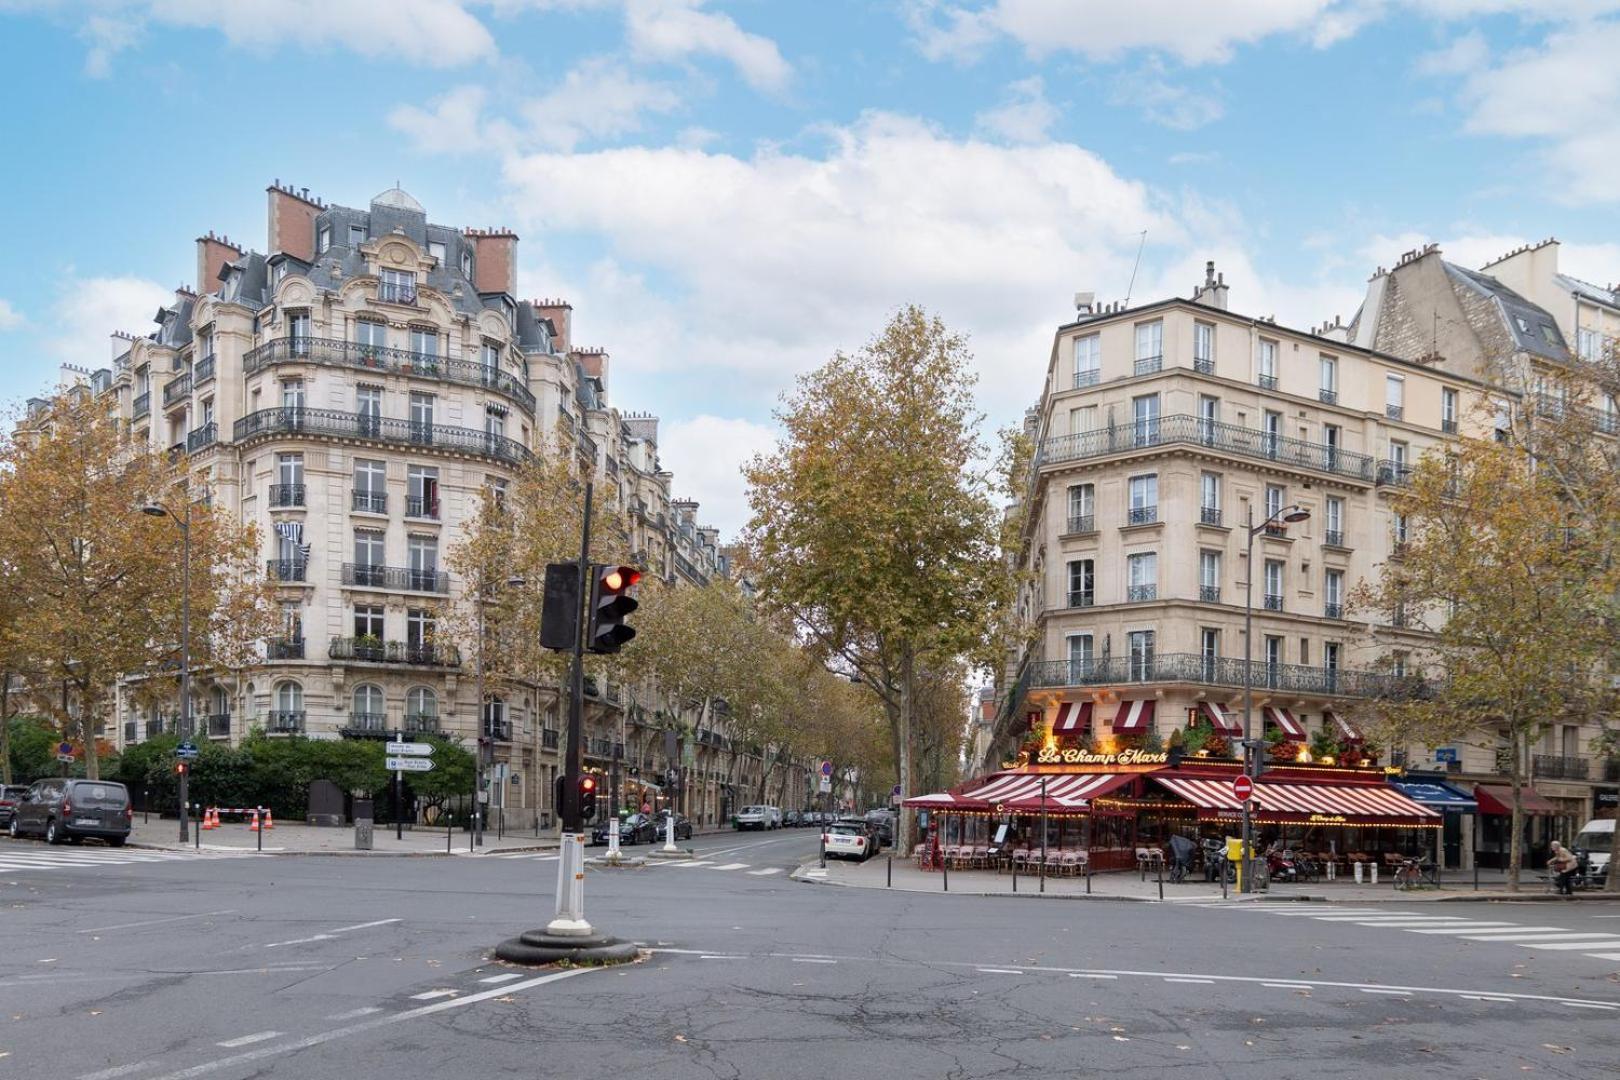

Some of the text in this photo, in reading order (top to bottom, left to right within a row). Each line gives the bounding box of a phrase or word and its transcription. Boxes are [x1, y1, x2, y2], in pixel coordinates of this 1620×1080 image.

[1037, 749, 1061, 763] Le
[1062, 749, 1116, 765] Champ
[1117, 748, 1169, 765] Mars
